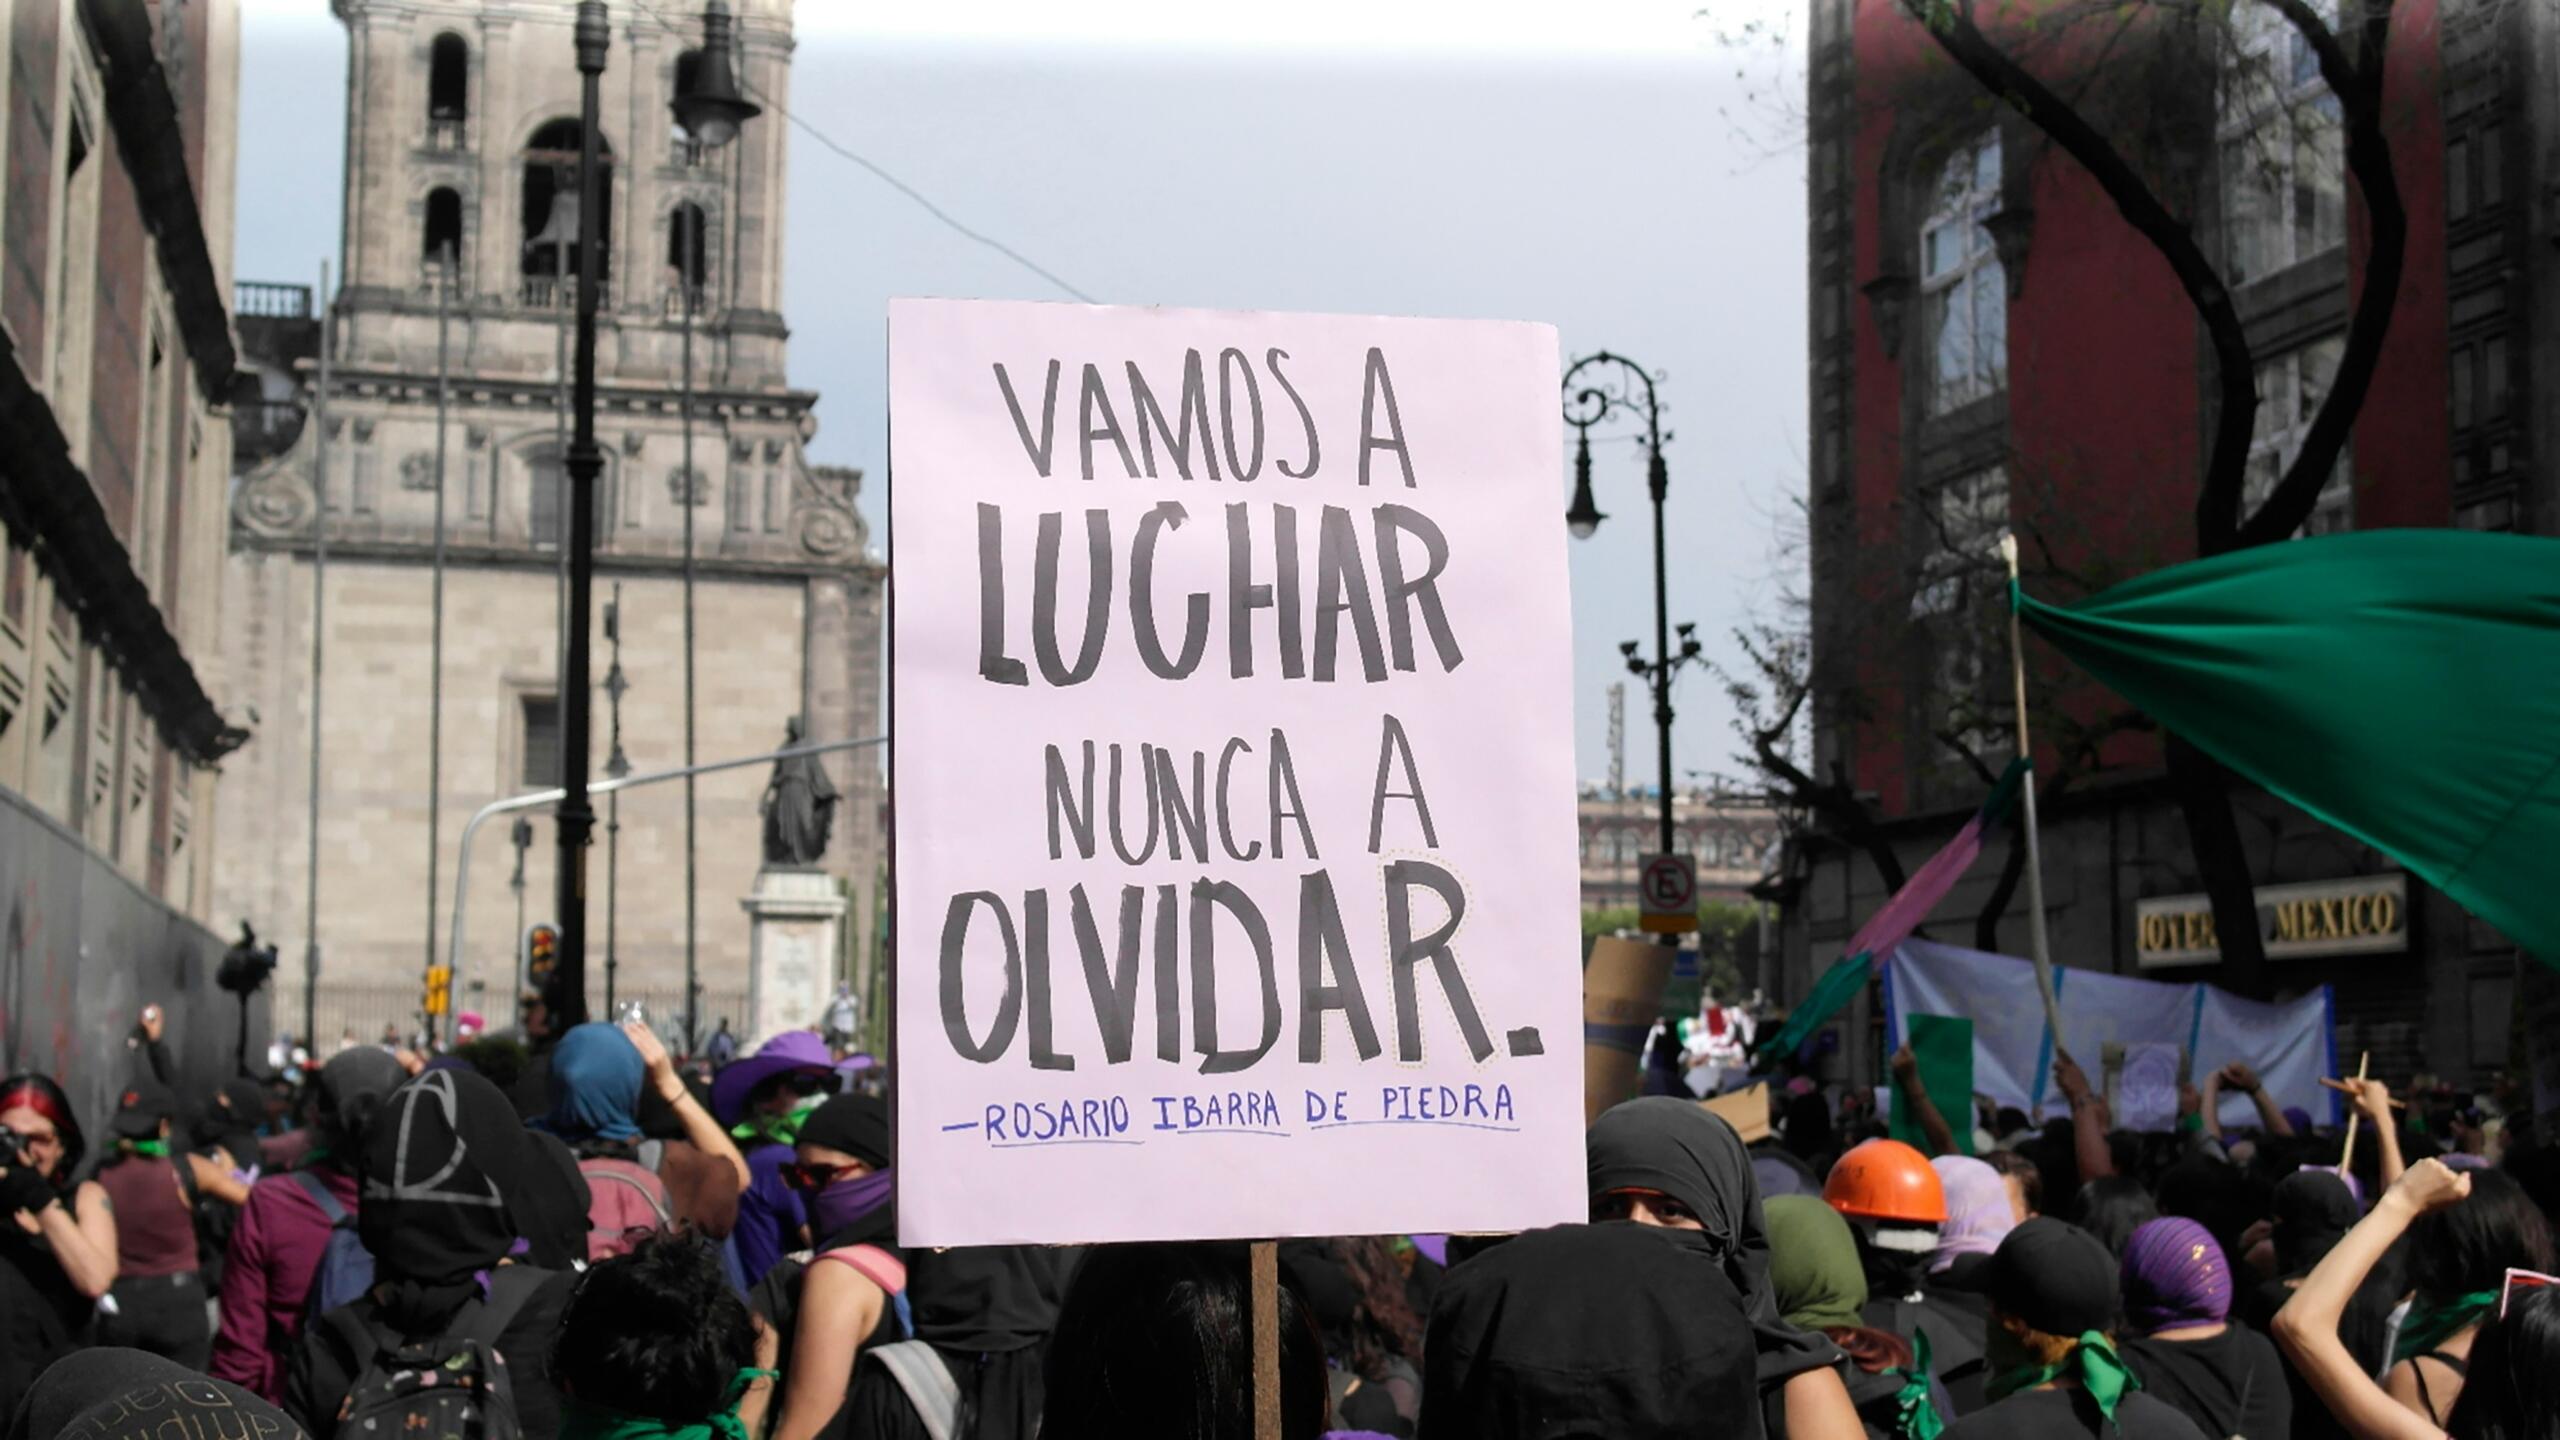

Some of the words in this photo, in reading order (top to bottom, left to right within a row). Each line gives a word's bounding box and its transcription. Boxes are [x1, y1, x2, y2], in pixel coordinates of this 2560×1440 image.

[993, 347, 1320, 482] VAMOS
[1358, 347, 1417, 489] A
[977, 501, 1465, 687] LUCHAR
[1045, 728, 1319, 866] NUNCA
[1368, 714, 1439, 853] A
[939, 860, 1546, 1075] OLVIDAR.
[2275, 891, 2396, 942] MEXICO
[1152, 1090, 1281, 1131] IBARRA
[1305, 1089, 1348, 1123] DE
[1382, 1083, 1515, 1122] PIEDRA
